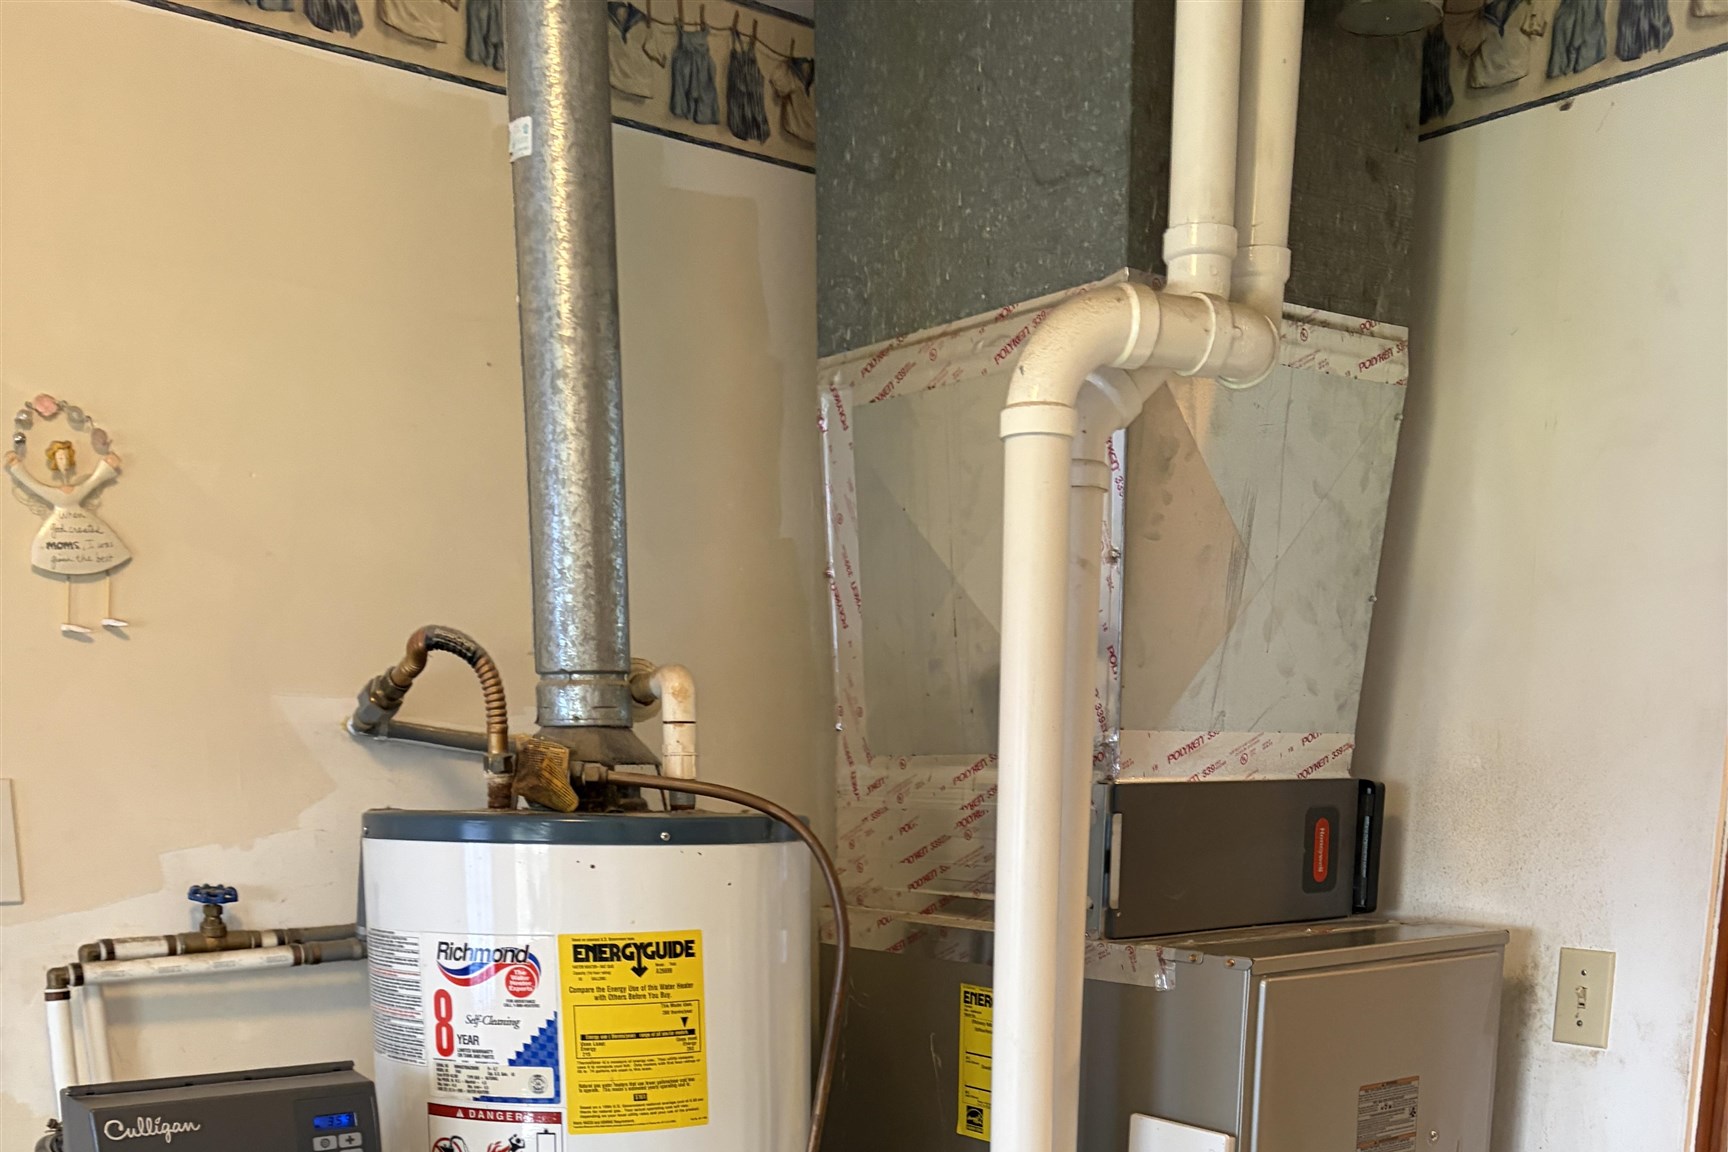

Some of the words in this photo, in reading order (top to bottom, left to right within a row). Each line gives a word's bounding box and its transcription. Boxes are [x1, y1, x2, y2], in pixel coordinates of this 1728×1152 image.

[436, 941, 530, 963] Richmond
[434, 988, 455, 1057] 8
[465, 1014, 520, 1029] Self-Cleaning
[457, 1034, 480, 1046] YEAR
[468, 1109, 524, 1121] DANGER
[103, 1116, 200, 1143] Culligan
